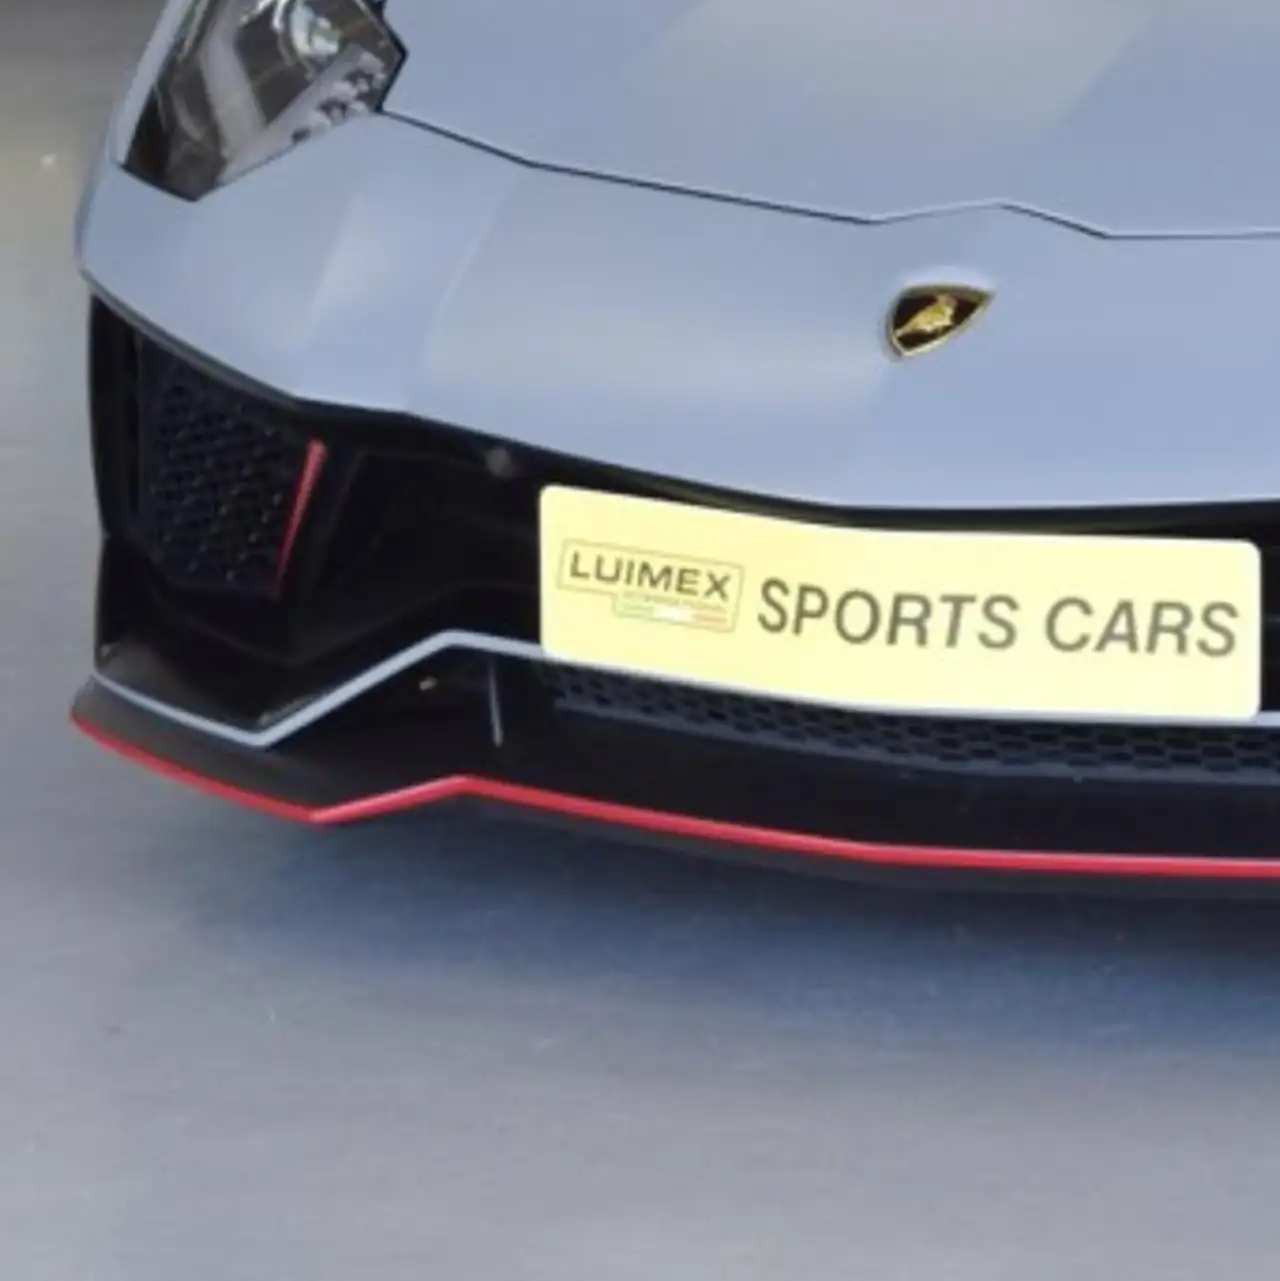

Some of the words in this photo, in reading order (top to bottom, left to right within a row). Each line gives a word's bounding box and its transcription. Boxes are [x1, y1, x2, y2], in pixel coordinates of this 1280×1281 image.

[569, 549, 731, 602] LUIMEX
[757, 576, 1021, 651] SPORTS
[1044, 595, 1239, 658] CARS
